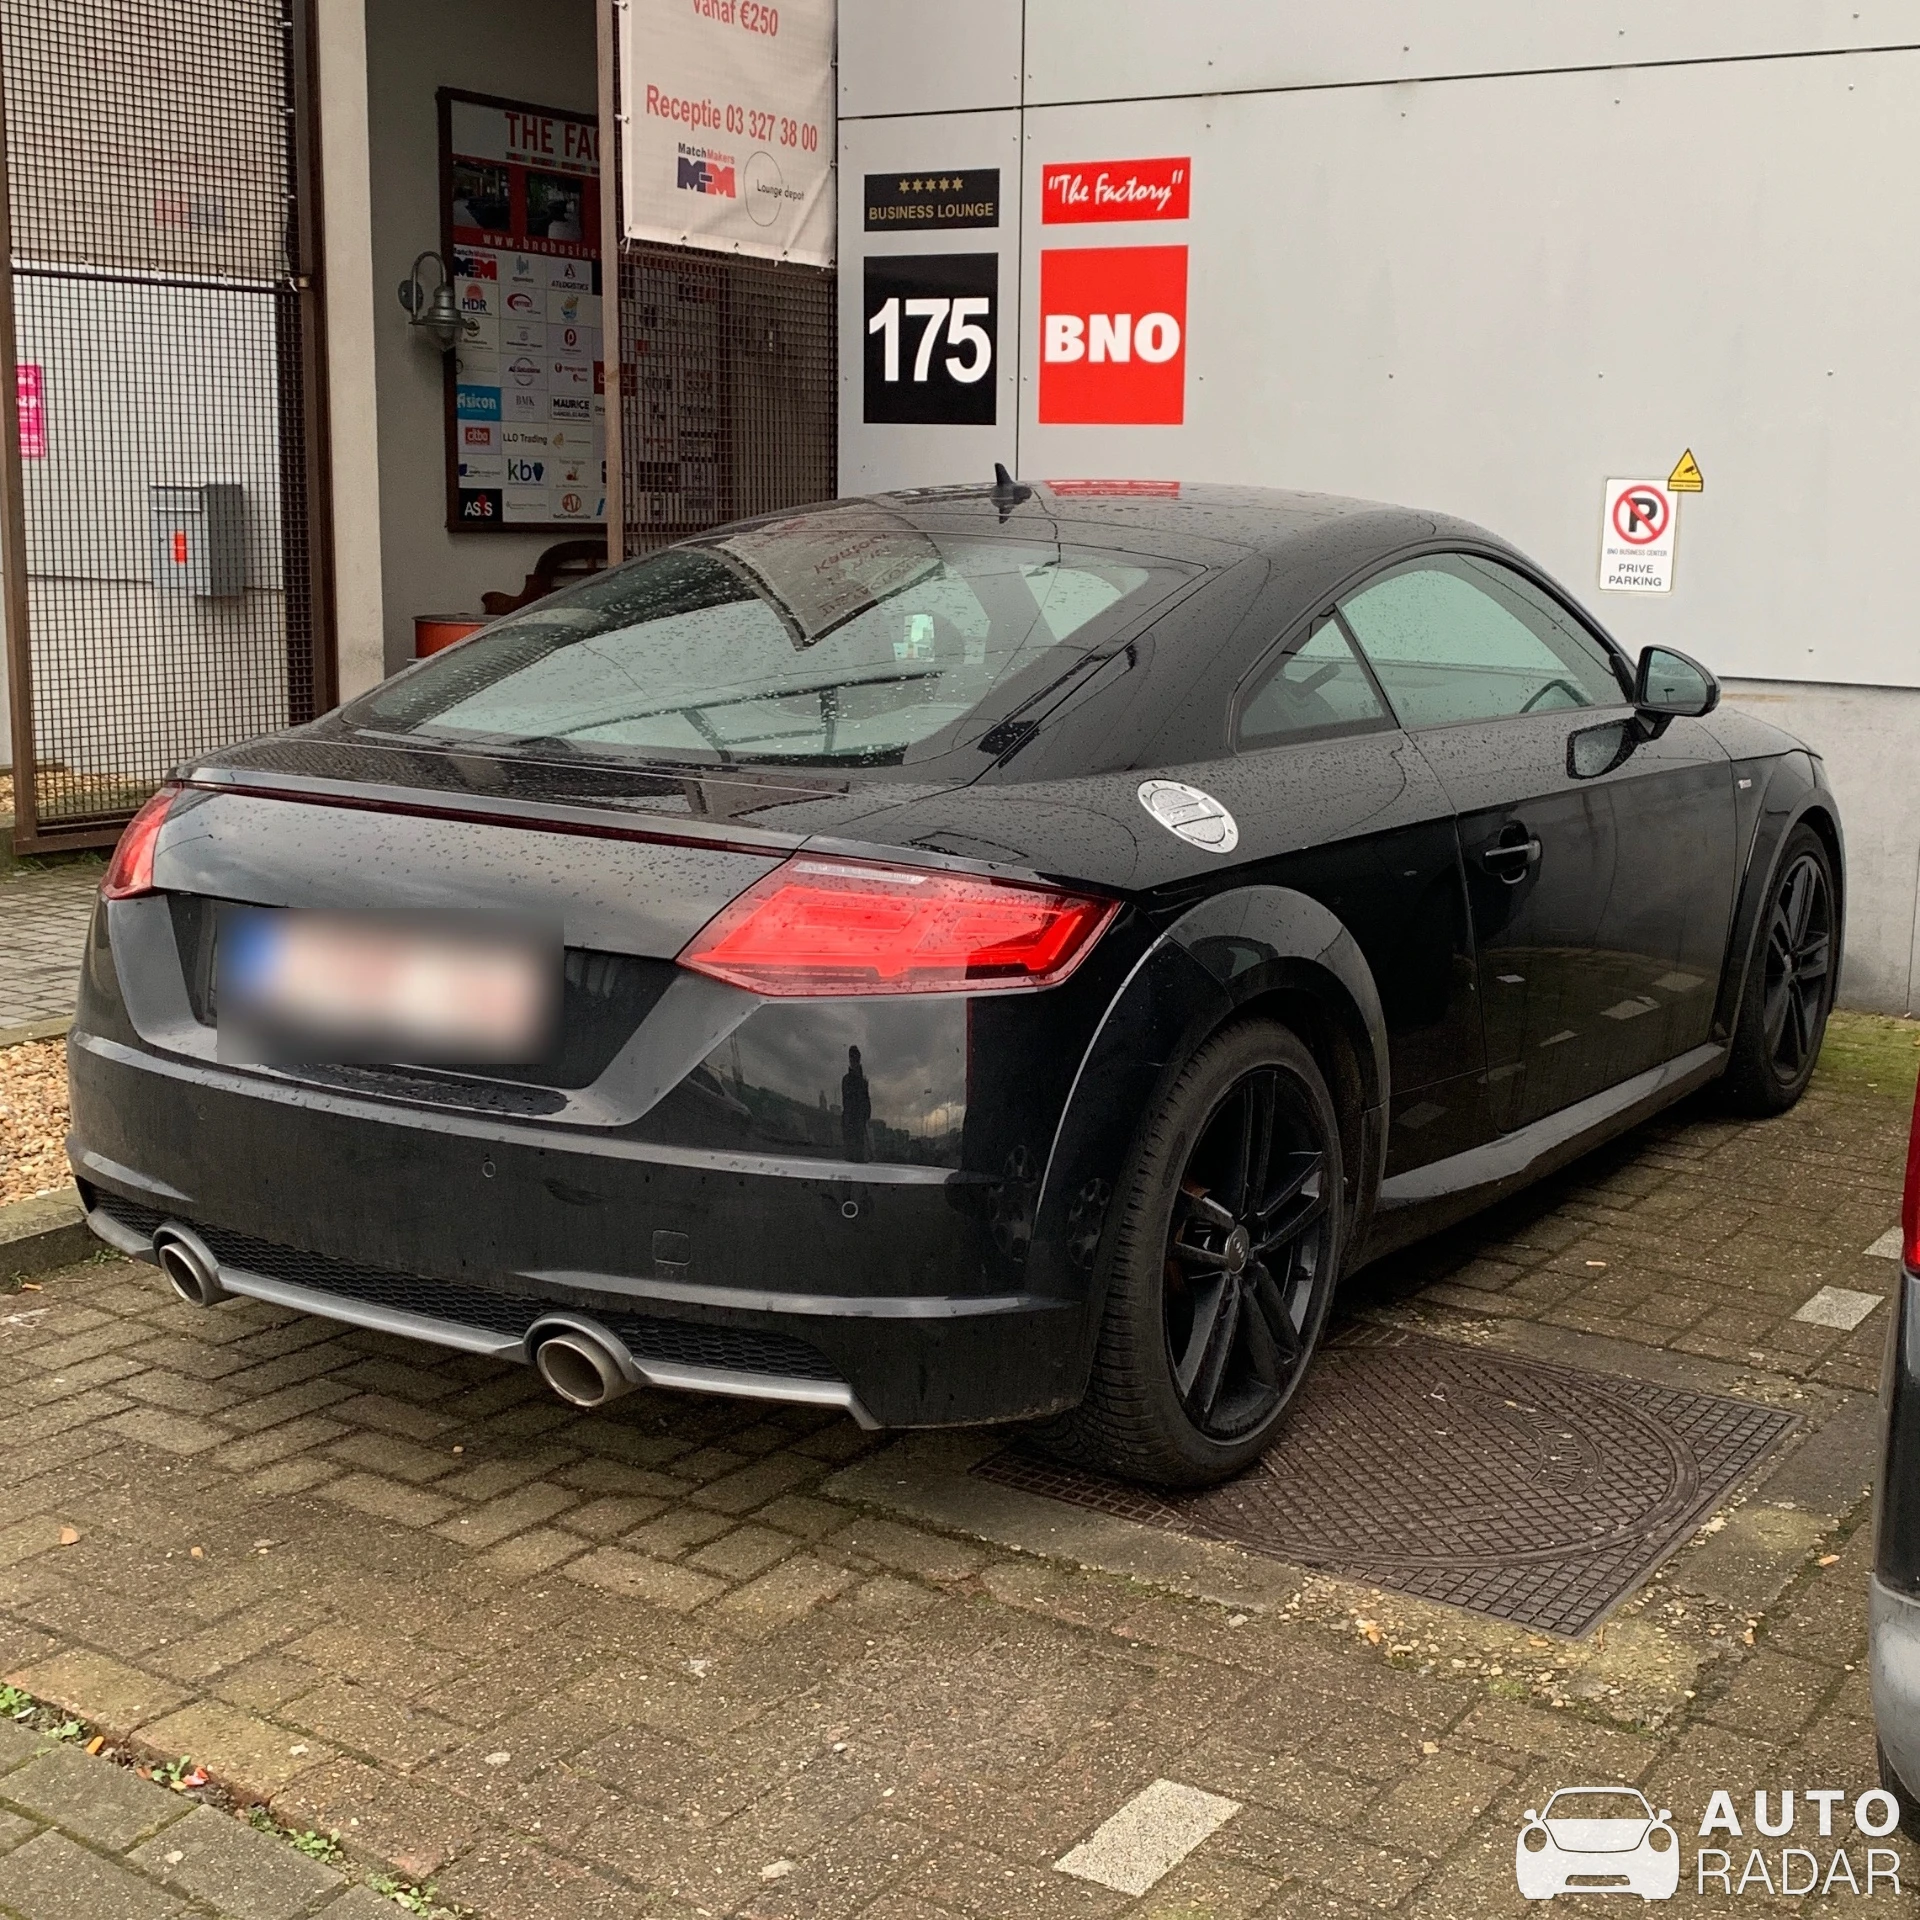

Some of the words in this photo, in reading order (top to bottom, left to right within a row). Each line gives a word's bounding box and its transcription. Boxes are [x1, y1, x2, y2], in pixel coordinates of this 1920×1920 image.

[740, 0, 778, 37] €250
[646, 84, 721, 131] Receptie
[726, 104, 744, 135] 03
[749, 110, 775, 142] 327
[780, 117, 797, 147] 38
[802, 123, 818, 152] 00
[505, 112, 554, 155] THE
[756, 179, 783, 198] Lounge
[784, 186, 805, 201] depot
[868, 203, 934, 220] BUSINESS
[937, 202, 994, 219] LOUNGE
[462, 297, 487, 311] HDR
[868, 297, 992, 383] 175
[1044, 312, 1181, 363] BNO
[553, 398, 590, 410] MAURICE
[1619, 548, 1646, 556] BUSINESS
[1618, 563, 1654, 574] PRIVE
[1608, 575, 1662, 587] PARKING
